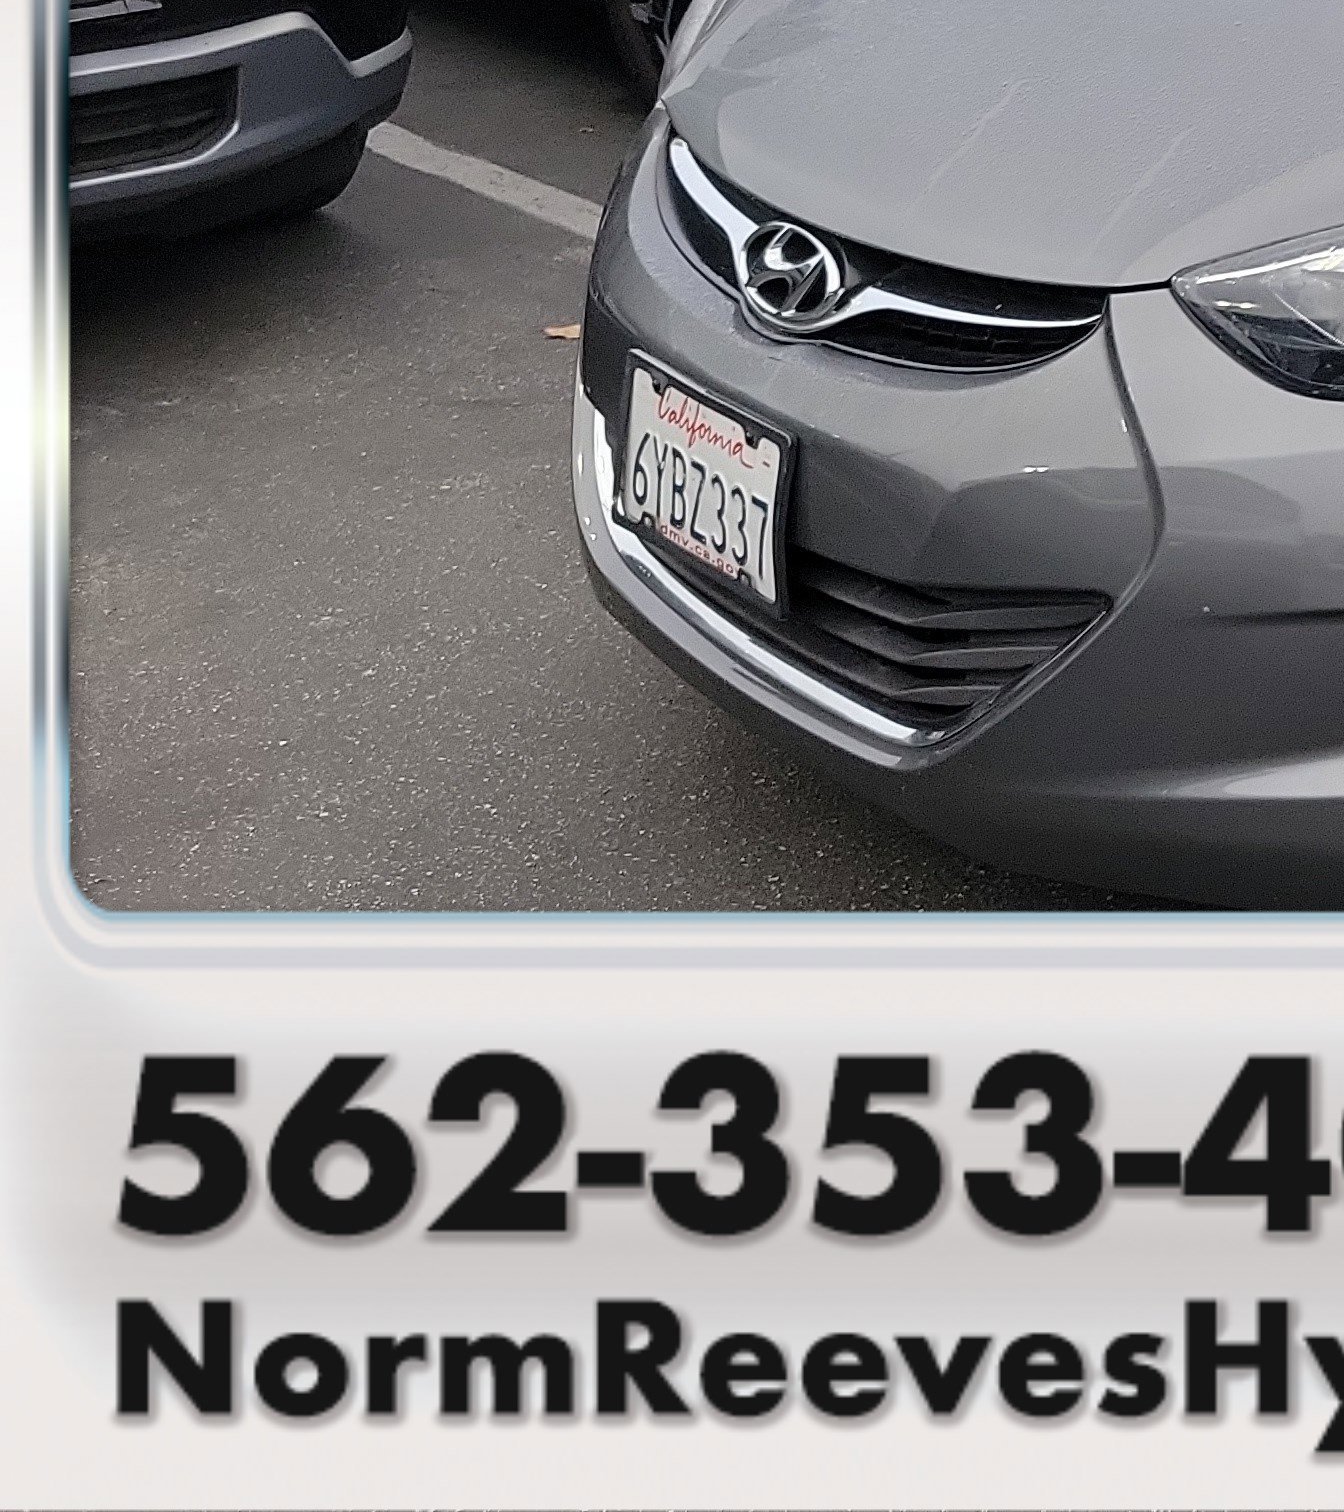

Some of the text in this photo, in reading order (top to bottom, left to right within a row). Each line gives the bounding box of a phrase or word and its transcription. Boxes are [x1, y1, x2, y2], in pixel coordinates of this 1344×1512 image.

[658, 390, 754, 469] California
[633, 432, 769, 580] 6YBZ337
[660, 524, 738, 575] dmv.ca.go
